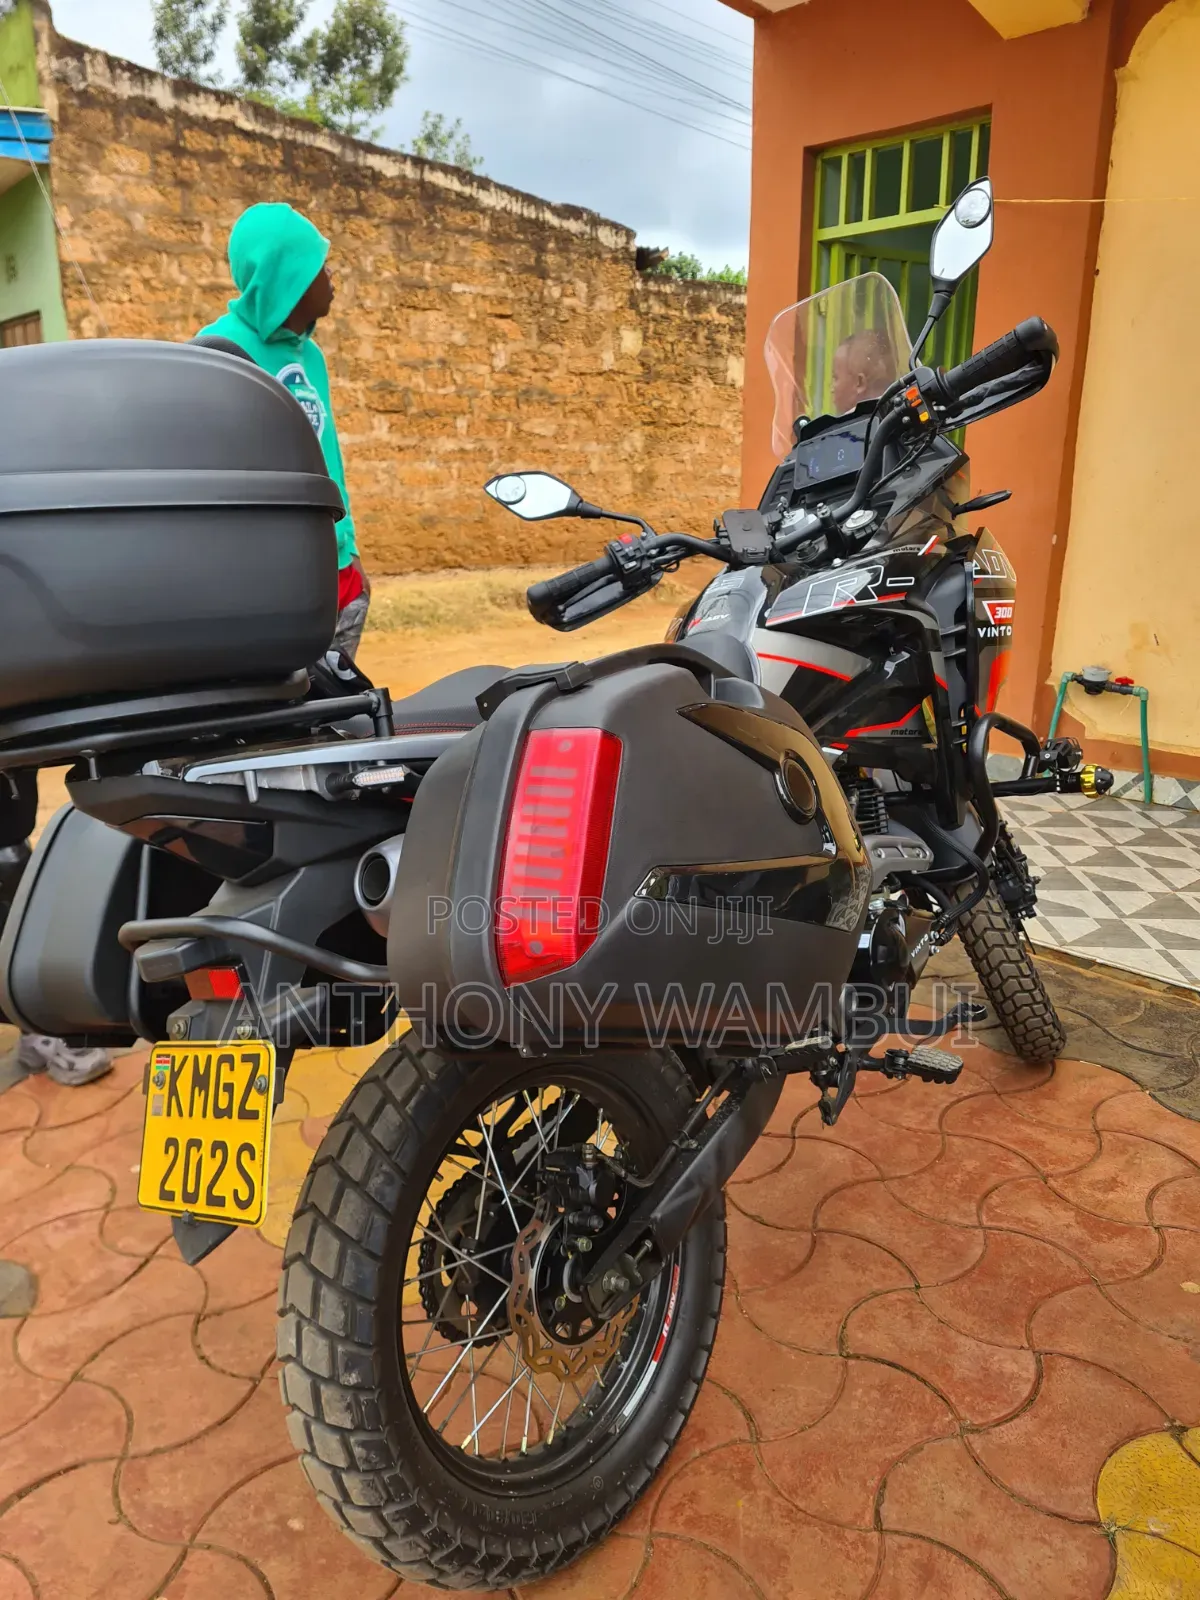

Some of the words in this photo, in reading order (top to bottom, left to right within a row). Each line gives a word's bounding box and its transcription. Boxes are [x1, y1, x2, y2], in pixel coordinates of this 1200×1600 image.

[977, 625, 1013, 639] VINTO
[994, 606, 1013, 619] 300
[166, 1053, 262, 1121] KMGZ
[158, 1136, 257, 1211] 202S
